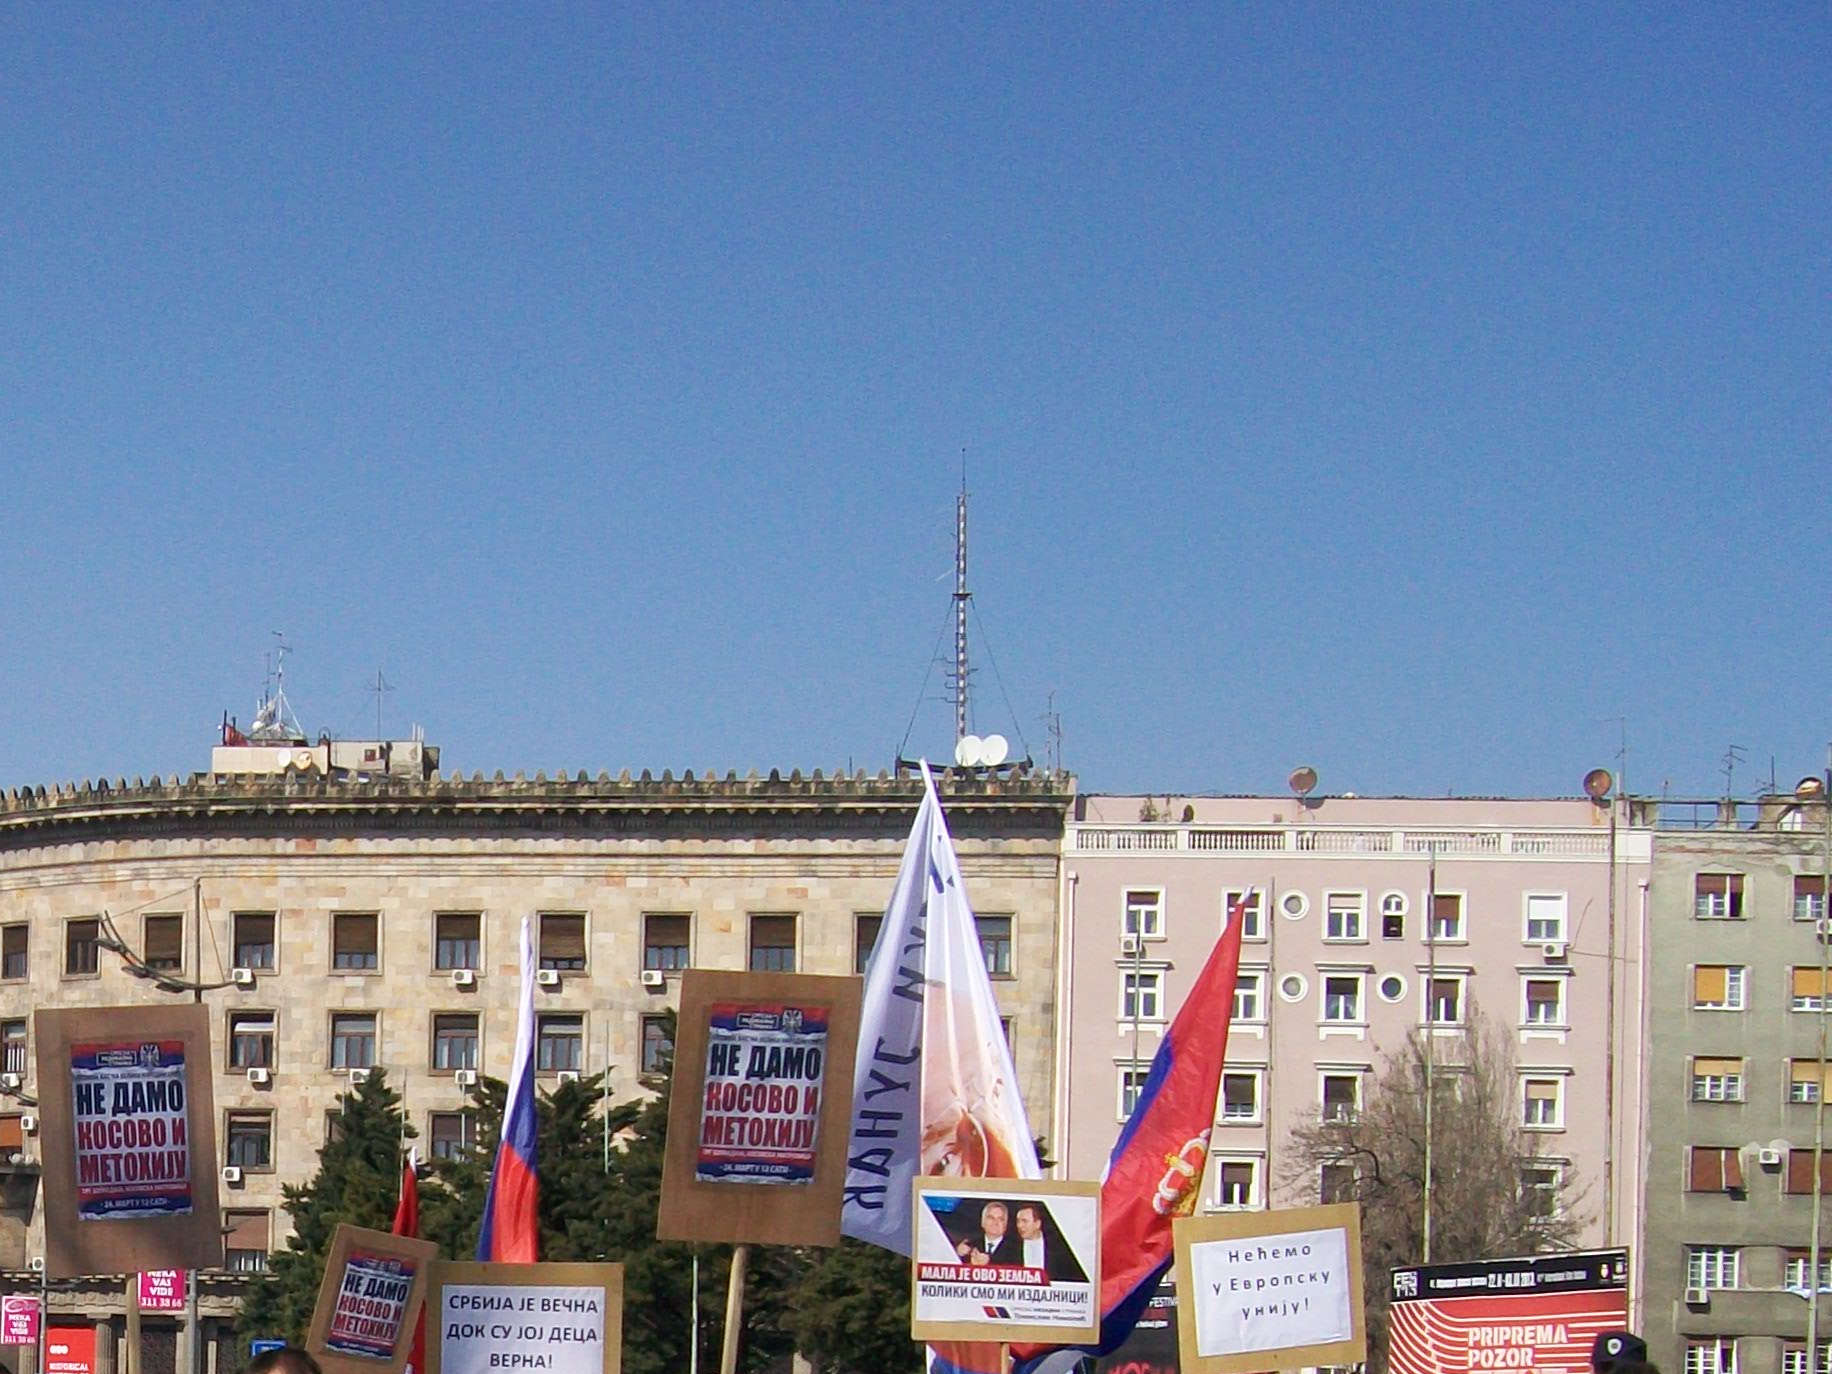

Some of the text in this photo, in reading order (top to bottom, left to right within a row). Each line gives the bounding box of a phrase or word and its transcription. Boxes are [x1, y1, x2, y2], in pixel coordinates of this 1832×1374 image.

[709, 1044, 822, 1081] НЕ ДАМО
[75, 1080, 184, 1117] НЕ ДАМО
[705, 1082, 819, 1116] КОСОВО И
[77, 1118, 186, 1150] КОСОВО И
[702, 1116, 816, 1149] МЕТОХИЈУ
[79, 1150, 187, 1184] МЕТОХИЈУ
[1228, 1245, 1312, 1263] Нећемо
[343, 1273, 408, 1302] НЕ ДАМО
[921, 1266, 1041, 1284] МАЛА ЈЕ ОВО ЗЕМЉА
[1212, 1271, 1330, 1296] у Европску
[448, 1295, 599, 1314] СРБИЈА ЈЕ ВЕЧНА
[921, 1284, 1088, 1305] КОЛИКИ СМО МИ ИЗДАЈНИЦИ!
[338, 1294, 404, 1322] КОСОВО И
[1241, 1297, 1309, 1320] унију!
[333, 1313, 398, 1339] МЕТОХИЈУ
[446, 1323, 598, 1344] ДОК СУ ЈОЈ ДЕЦА
[1468, 1324, 1568, 1347] PRIPREMA
[489, 1353, 553, 1369] ВЕРНА!
[1468, 1347, 1535, 1368] POZOR
